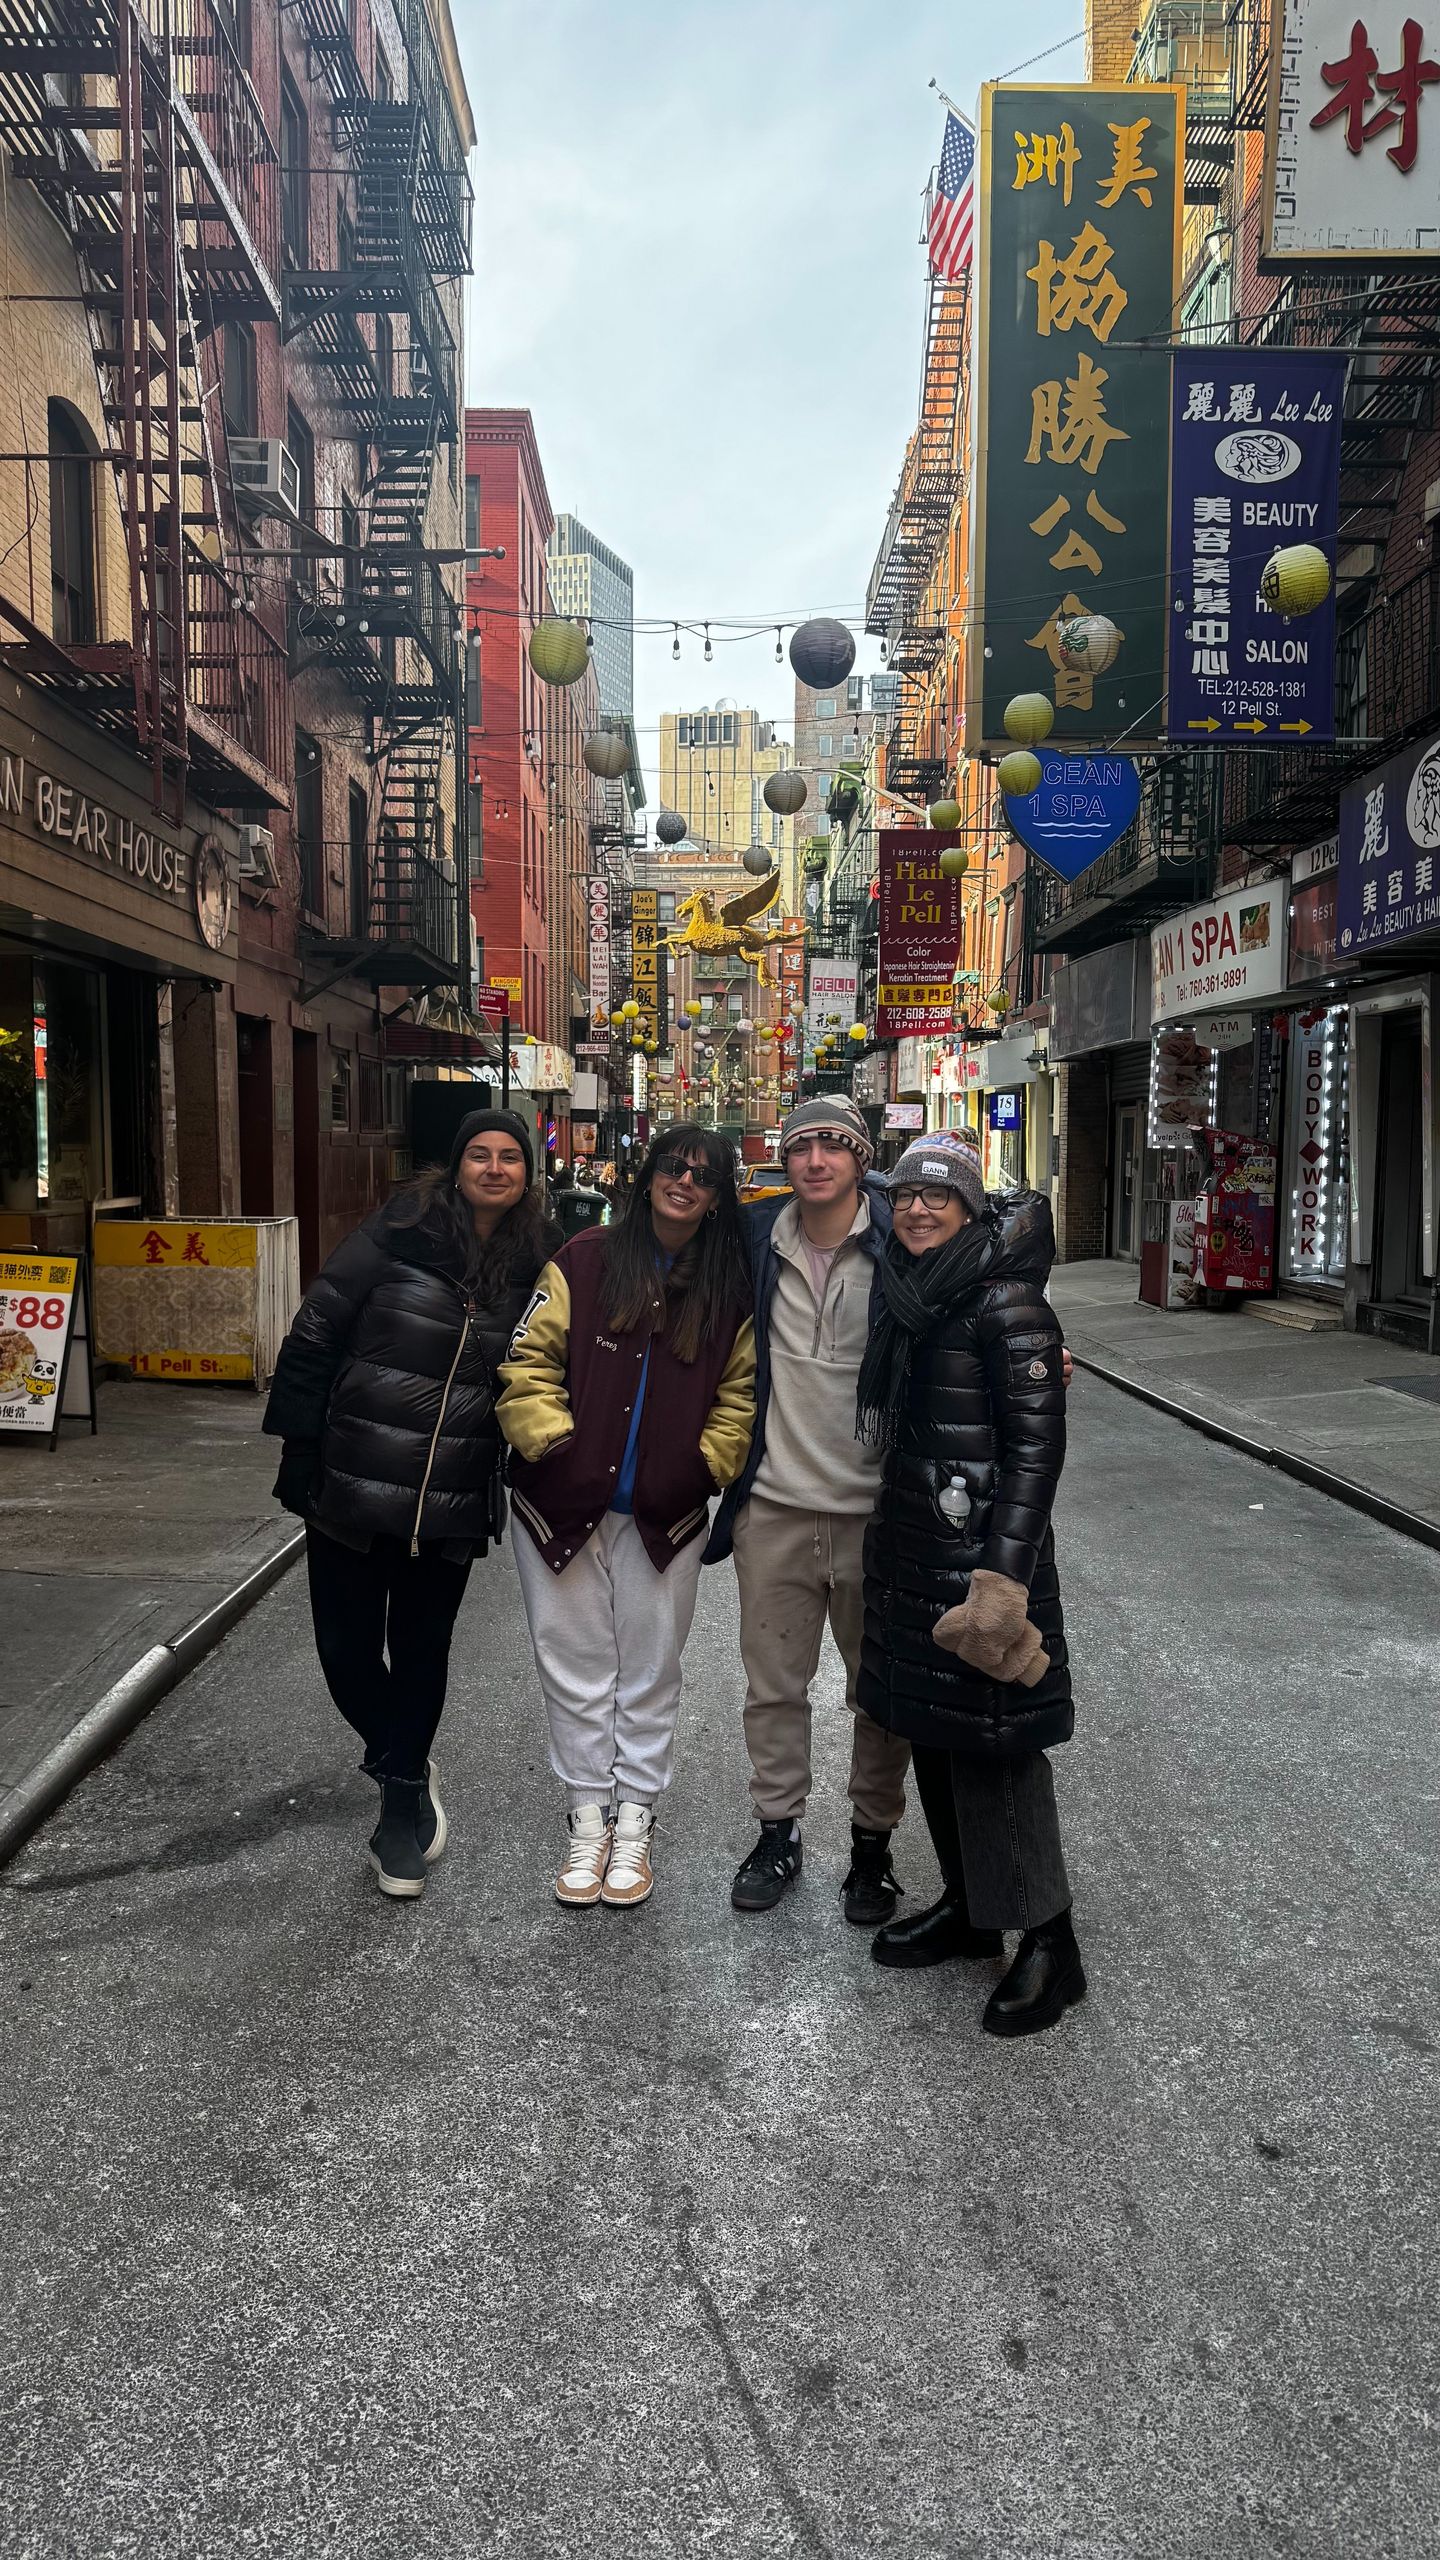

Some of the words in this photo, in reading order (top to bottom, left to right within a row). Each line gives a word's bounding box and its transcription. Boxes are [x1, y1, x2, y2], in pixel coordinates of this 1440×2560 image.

[1308, 18, 1440, 172] 材
[1270, 390, 1300, 422] Lee
[1303, 390, 1333, 423] Lee
[1243, 502, 1319, 527] BEAUTY
[1246, 639, 1308, 664] SALON
[1198, 679, 1307, 698] TEL:212-528-1381
[1221, 700, 1236, 715] 12
[1240, 701, 1262, 716] Pell
[1265, 702, 1283, 717] St.
[1043, 762, 1122, 786] CEAN
[1028, 794, 1040, 817] 1
[1051, 794, 1106, 818] SPA
[0, 756, 25, 816] N
[36, 775, 112, 861] BEAR
[119, 818, 187, 894] HOUSE
[1310, 850, 1320, 875] 12
[1322, 845, 1339, 869] Pel
[636, 894, 653, 903] Joe's
[907, 884, 935, 902] Le
[634, 905, 656, 916] Ginger
[900, 904, 942, 924] Pell
[950, 877, 958, 932] 18Pell.co
[1313, 902, 1334, 923] BEST
[1357, 921, 1369, 943] Lee
[1370, 916, 1382, 938] Lee
[1384, 905, 1415, 935] BEAUTY
[1416, 903, 1422, 924] &
[1177, 928, 1185, 972] 1
[1191, 911, 1237, 967] SPA
[1314, 942, 1321, 957] IN
[1325, 938, 1337, 954] THE
[906, 946, 932, 957] Color
[908, 961, 920, 970] Hair
[921, 960, 955, 972] Straightenin
[813, 979, 855, 991] PELL
[888, 973, 913, 982] Keratin
[914, 972, 948, 982] Treatment
[1176, 985, 1188, 1002] Tel:
[1189, 966, 1247, 999] 760-361-9891
[592, 989, 608, 998] Bar
[831, 992, 856, 1000] SALON
[887, 1006, 952, 1020] 212-608-2588
[889, 1021, 946, 1029] 18Pell.com
[1210, 1021, 1239, 1033] ATM
[485, 1073, 519, 1085] SALN
[999, 1096, 1013, 1109] 18
[1304, 1050, 1323, 1139] BODY
[922, 1166, 947, 1176] GANNI
[1300, 1168, 1324, 1256] WORK
[139, 1229, 210, 1266] 金義
[9, 1296, 65, 1331] $88
[596, 1335, 618, 1352] Perez
[128, 1354, 149, 1372] 11
[160, 1358, 191, 1373] Pell
[200, 1358, 224, 1373] St.
[0, 1404, 28, 1419] 便當
